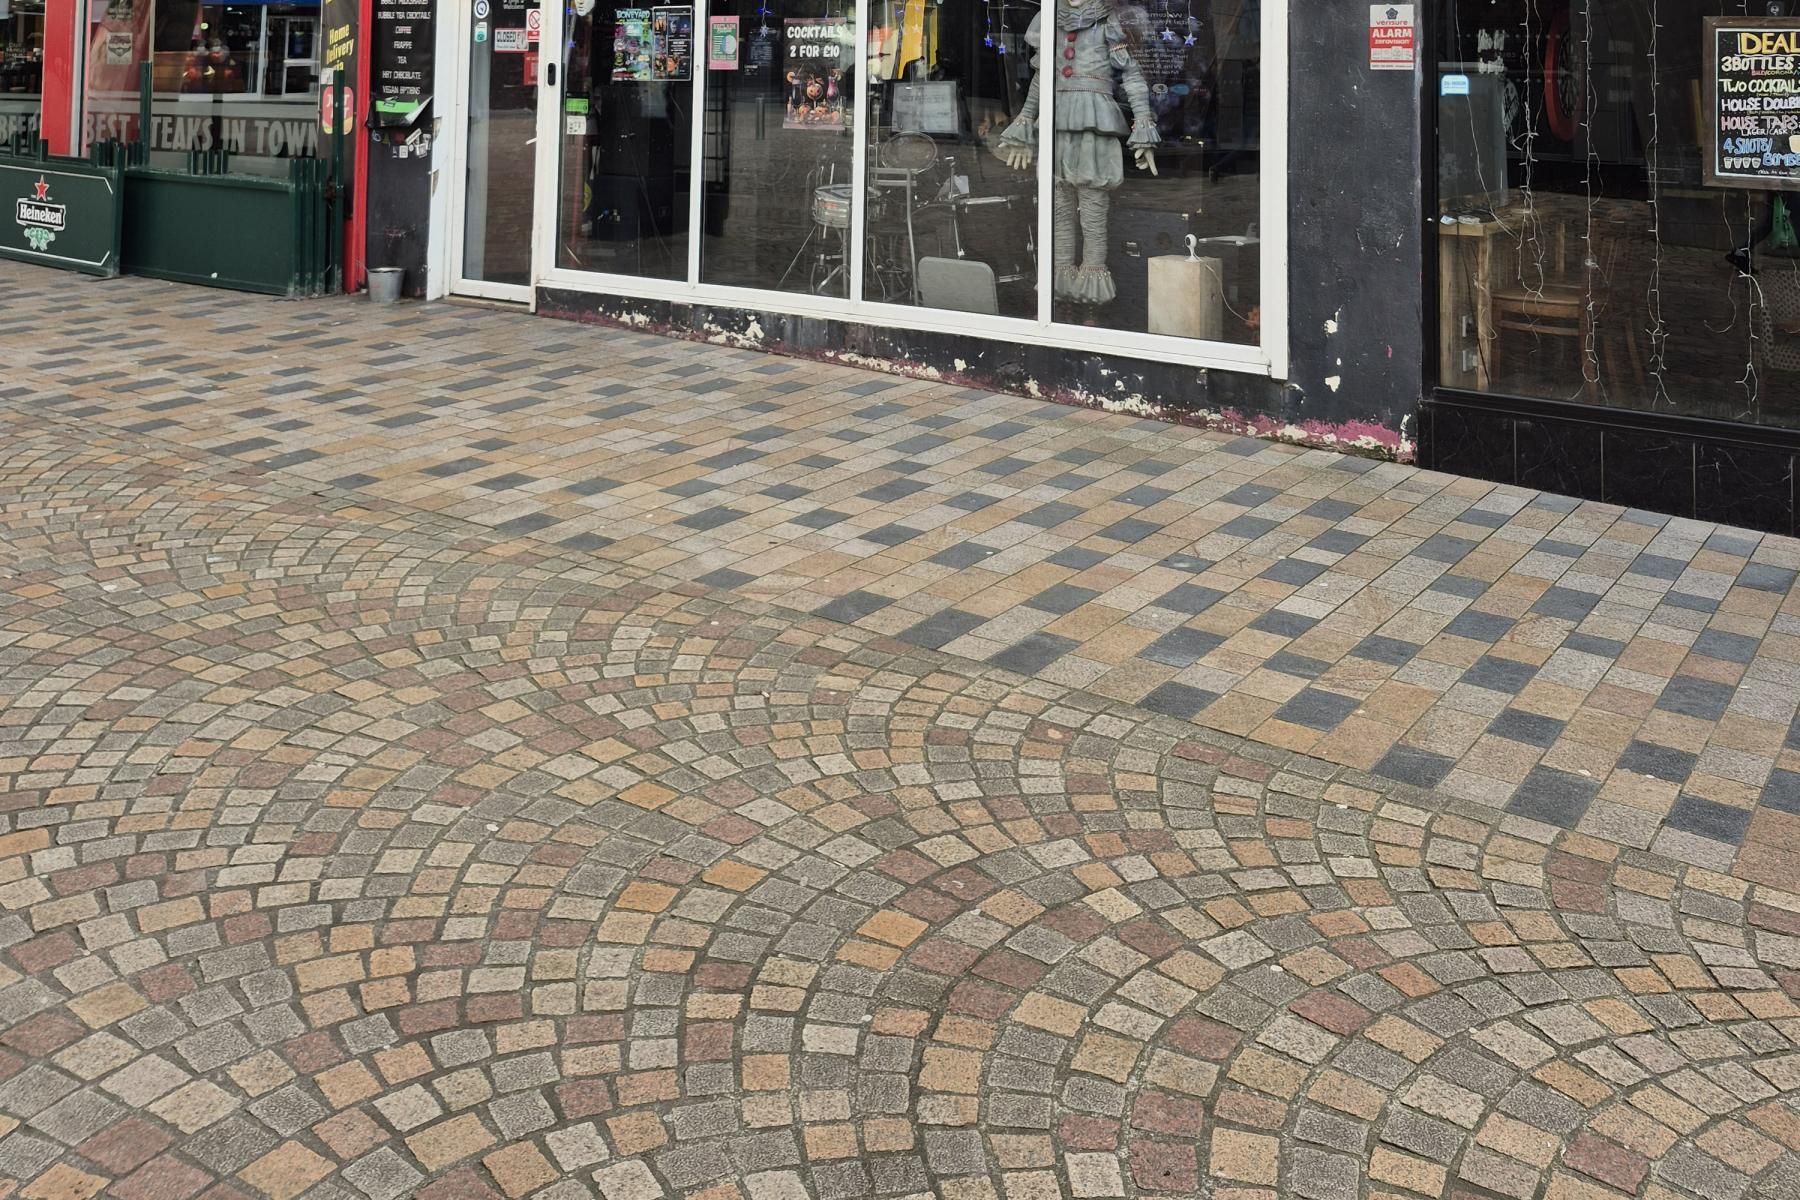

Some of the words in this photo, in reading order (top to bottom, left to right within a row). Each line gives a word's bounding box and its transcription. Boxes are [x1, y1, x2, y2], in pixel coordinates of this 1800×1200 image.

[330, 24, 349, 45] Home
[787, 25, 844, 39] COCKTAILS
[1372, 28, 1412, 38] ALARM
[790, 45, 797, 57] 2
[800, 45, 819, 57] FOR
[823, 45, 840, 57] £10
[398, 56, 407, 64] TEA
[1721, 98, 1761, 112] HOUSE
[1721, 116, 1759, 131] HOUSE
[140, 115, 213, 150] TEAKS
[222, 118, 247, 152] IN
[254, 120, 318, 156] TOWN
[20, 204, 62, 225] Heineken
